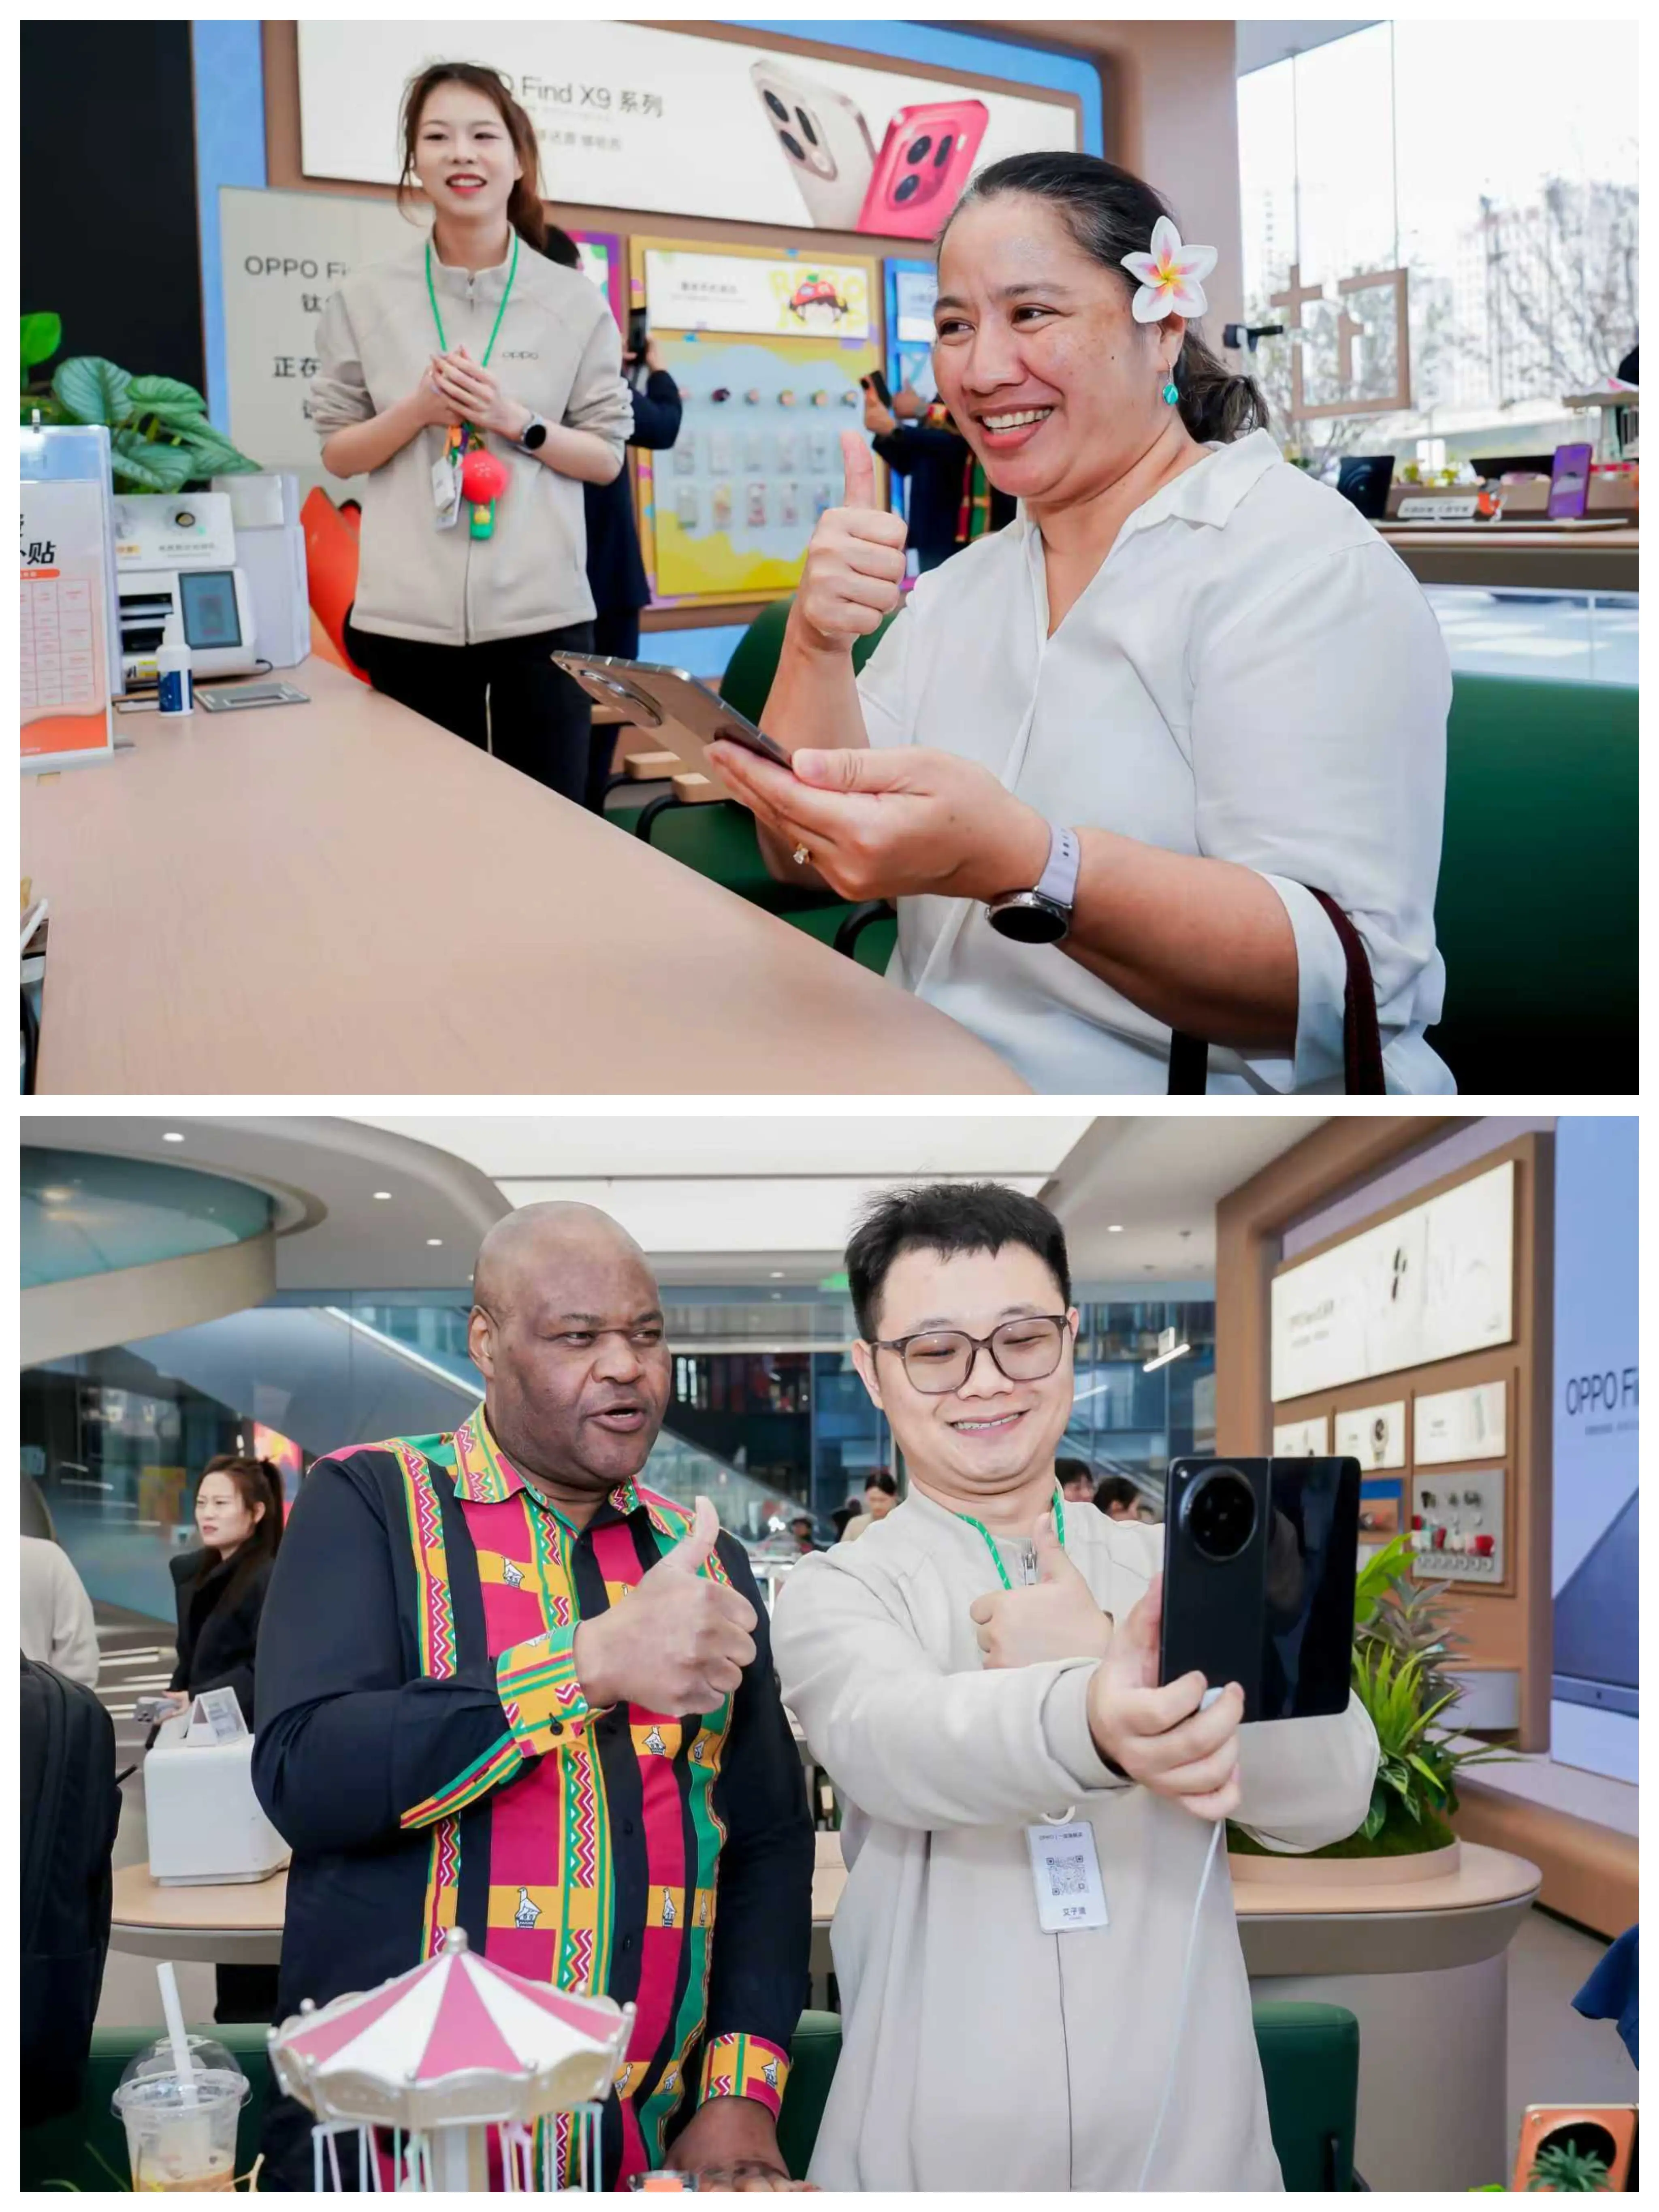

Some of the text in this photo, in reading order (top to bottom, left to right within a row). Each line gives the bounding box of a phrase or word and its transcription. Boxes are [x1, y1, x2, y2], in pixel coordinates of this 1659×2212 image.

[521, 76, 572, 103] Find
[580, 85, 611, 109] X9
[621, 90, 662, 118] 系列
[244, 256, 319, 279] OPPO
[21, 540, 56, 565] 贴
[1566, 1370, 1617, 1416] OPPO
